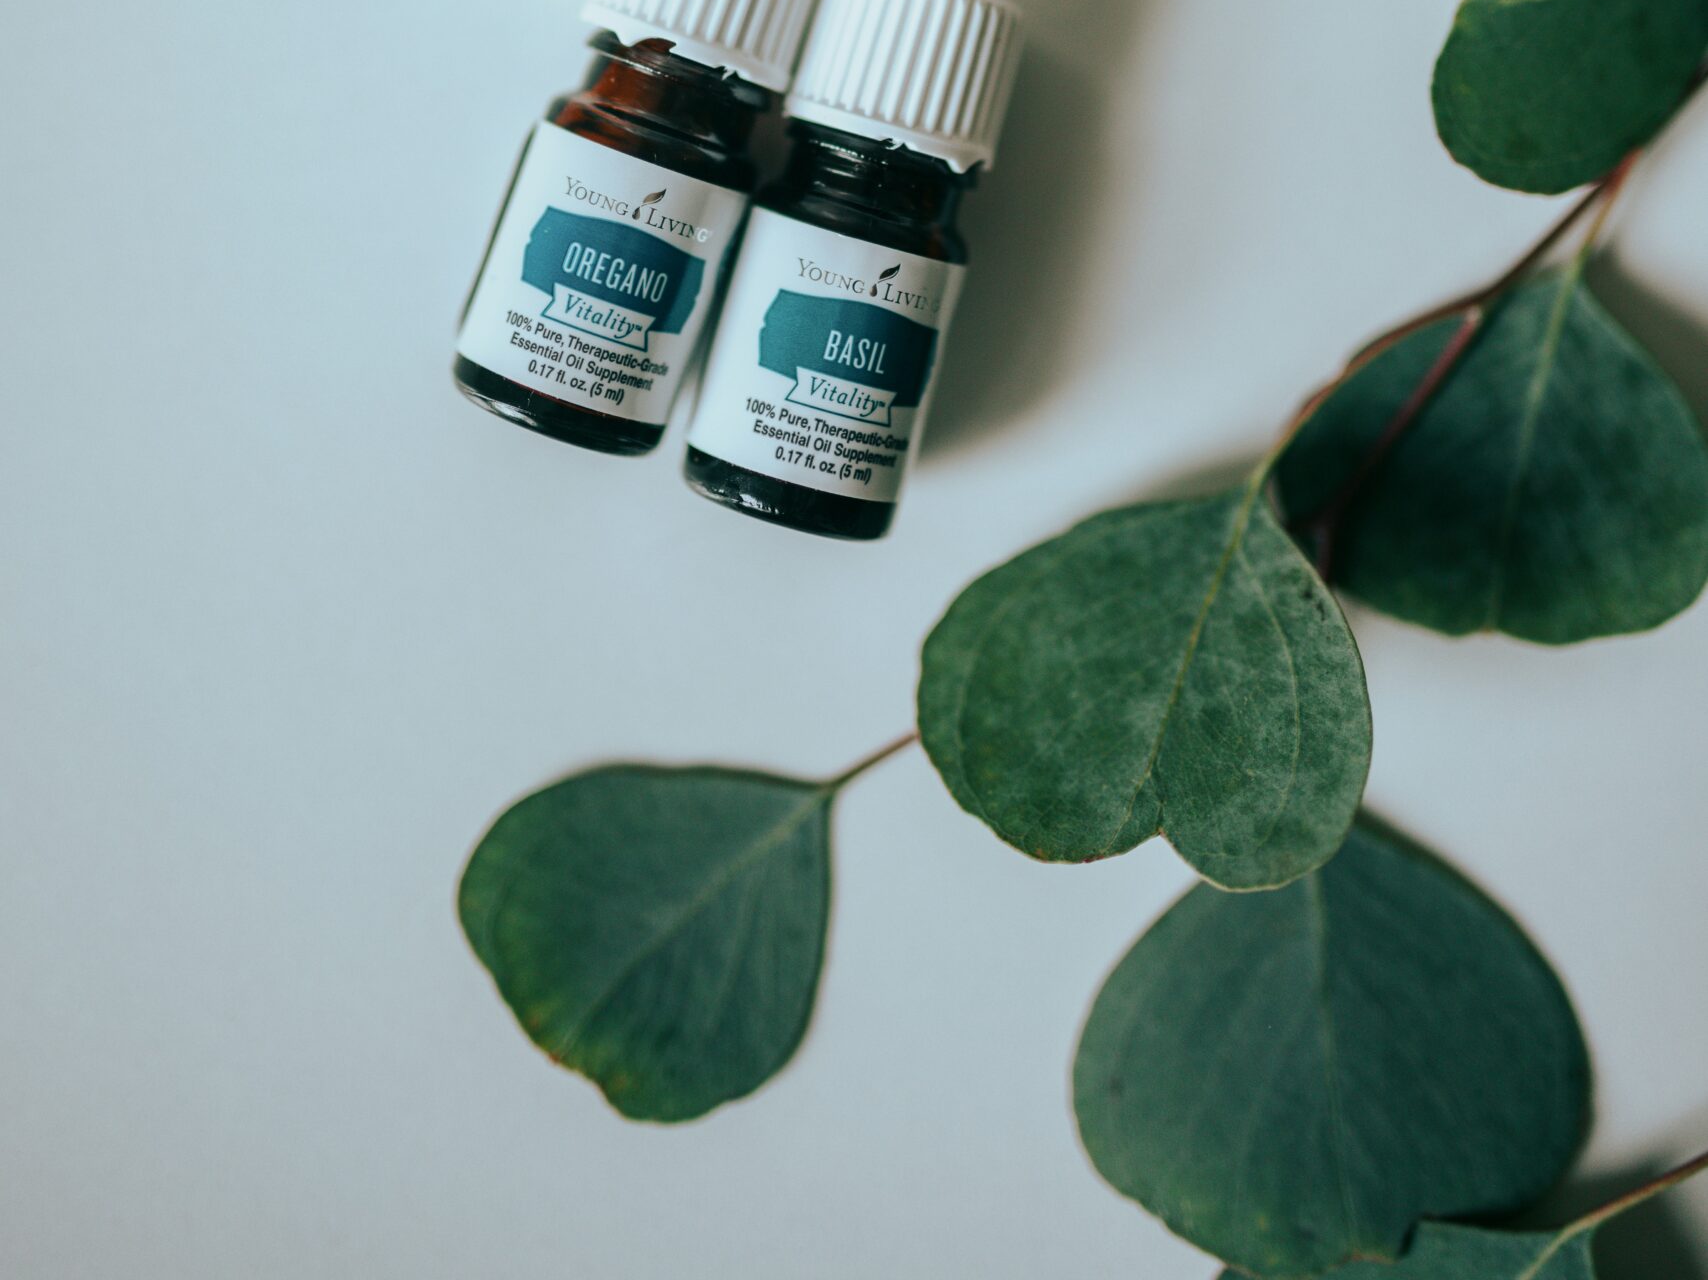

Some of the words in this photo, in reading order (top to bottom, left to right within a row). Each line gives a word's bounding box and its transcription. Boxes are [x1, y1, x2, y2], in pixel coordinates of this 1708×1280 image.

[565, 176, 629, 216] YOUNG
[562, 241, 668, 303] OREGANO
[797, 257, 866, 294] YOUNG
[505, 309, 532, 332] 100%
[534, 322, 564, 348] Pure,
[510, 331, 563, 362] Essential
[565, 354, 585, 371] Oil
[585, 360, 654, 391] Supplement
[823, 329, 887, 375] BASIL
[527, 359, 554, 380] 0.17
[555, 369, 567, 384] fl.
[569, 376, 588, 392] oz.
[589, 382, 602, 398] (5
[604, 388, 625, 406] ml)
[745, 397, 775, 419] 100%
[778, 408, 811, 432] Pure,
[813, 417, 909, 451] Therapeutic-Gra
[753, 419, 811, 447] Essential
[813, 437, 831, 454] Oil
[775, 445, 803, 465] 0.17
[804, 453, 816, 469] fl.
[819, 459, 837, 475] oz.
[839, 464, 852, 481] (5
[853, 469, 872, 485] ml)
